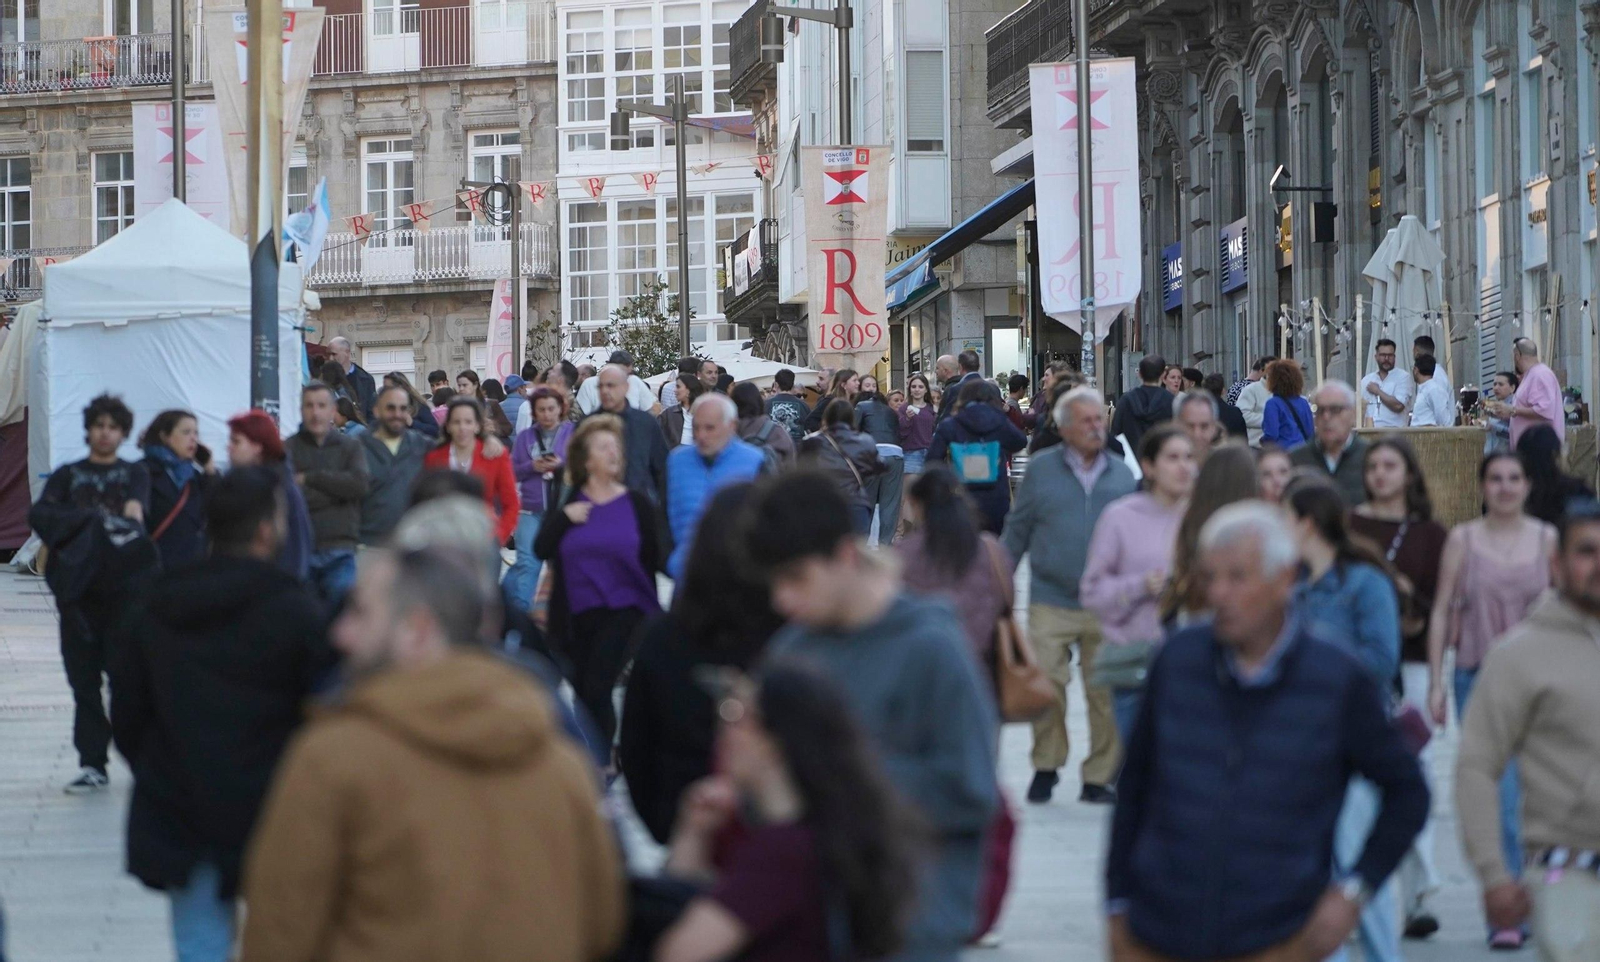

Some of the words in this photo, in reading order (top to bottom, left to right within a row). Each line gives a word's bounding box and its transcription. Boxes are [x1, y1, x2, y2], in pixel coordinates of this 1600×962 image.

[758, 156, 774, 174] R
[530, 184, 545, 203] R
[588, 178, 604, 197] R
[468, 190, 484, 211] R
[410, 204, 429, 223] R
[352, 215, 370, 235] R
[1228, 235, 1243, 261] MAS
[1168, 256, 1183, 281] MAS
[820, 248, 878, 316] R
[818, 322, 882, 350] 1809
